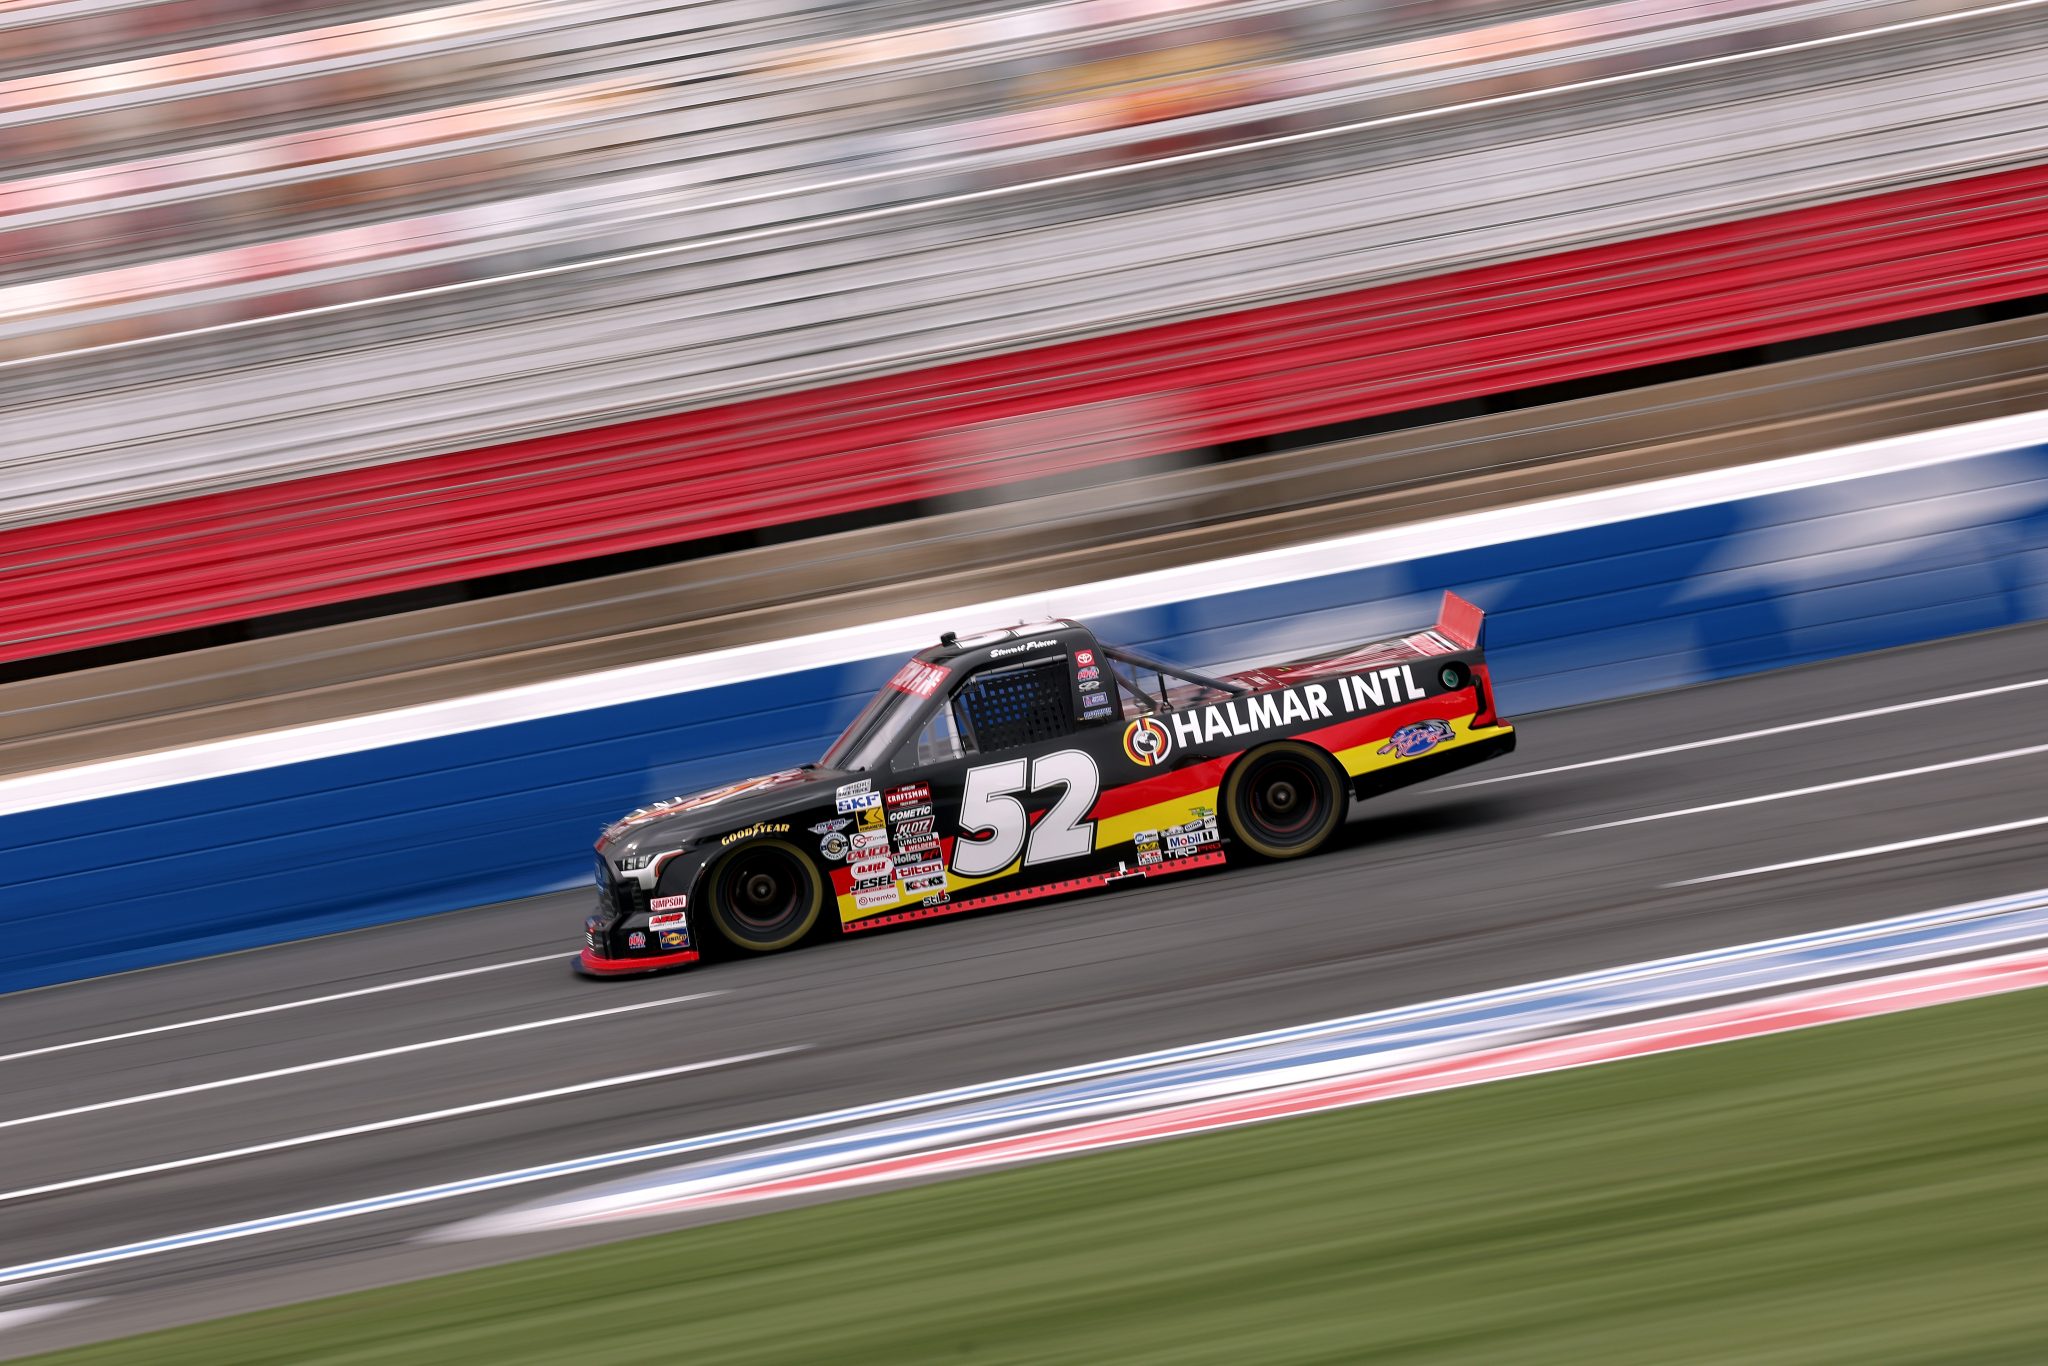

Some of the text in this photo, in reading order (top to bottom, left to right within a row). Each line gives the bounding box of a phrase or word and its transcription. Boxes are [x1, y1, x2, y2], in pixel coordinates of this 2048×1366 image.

[1171, 684, 1333, 748] HALMAR
[1338, 664, 1426, 713] INTL
[838, 793, 879, 812] SKF
[887, 788, 928, 803] CRAFTSMAN
[889, 805, 931, 822] COMETIC
[952, 749, 1099, 876] 52
[721, 822, 790, 847] GOODYEAR
[899, 819, 931, 835] KLOTZ
[900, 834, 932, 847] LINCOLN
[1169, 833, 1201, 848] Mobil
[847, 845, 890, 861] CALICO
[893, 852, 922, 865] Holley
[1164, 845, 1198, 859] TRD
[899, 864, 941, 877] tilton
[851, 875, 895, 891] JESEL
[905, 876, 943, 891] KOOKS
[651, 896, 684, 910] SIMPSON
[868, 892, 897, 903] brembo
